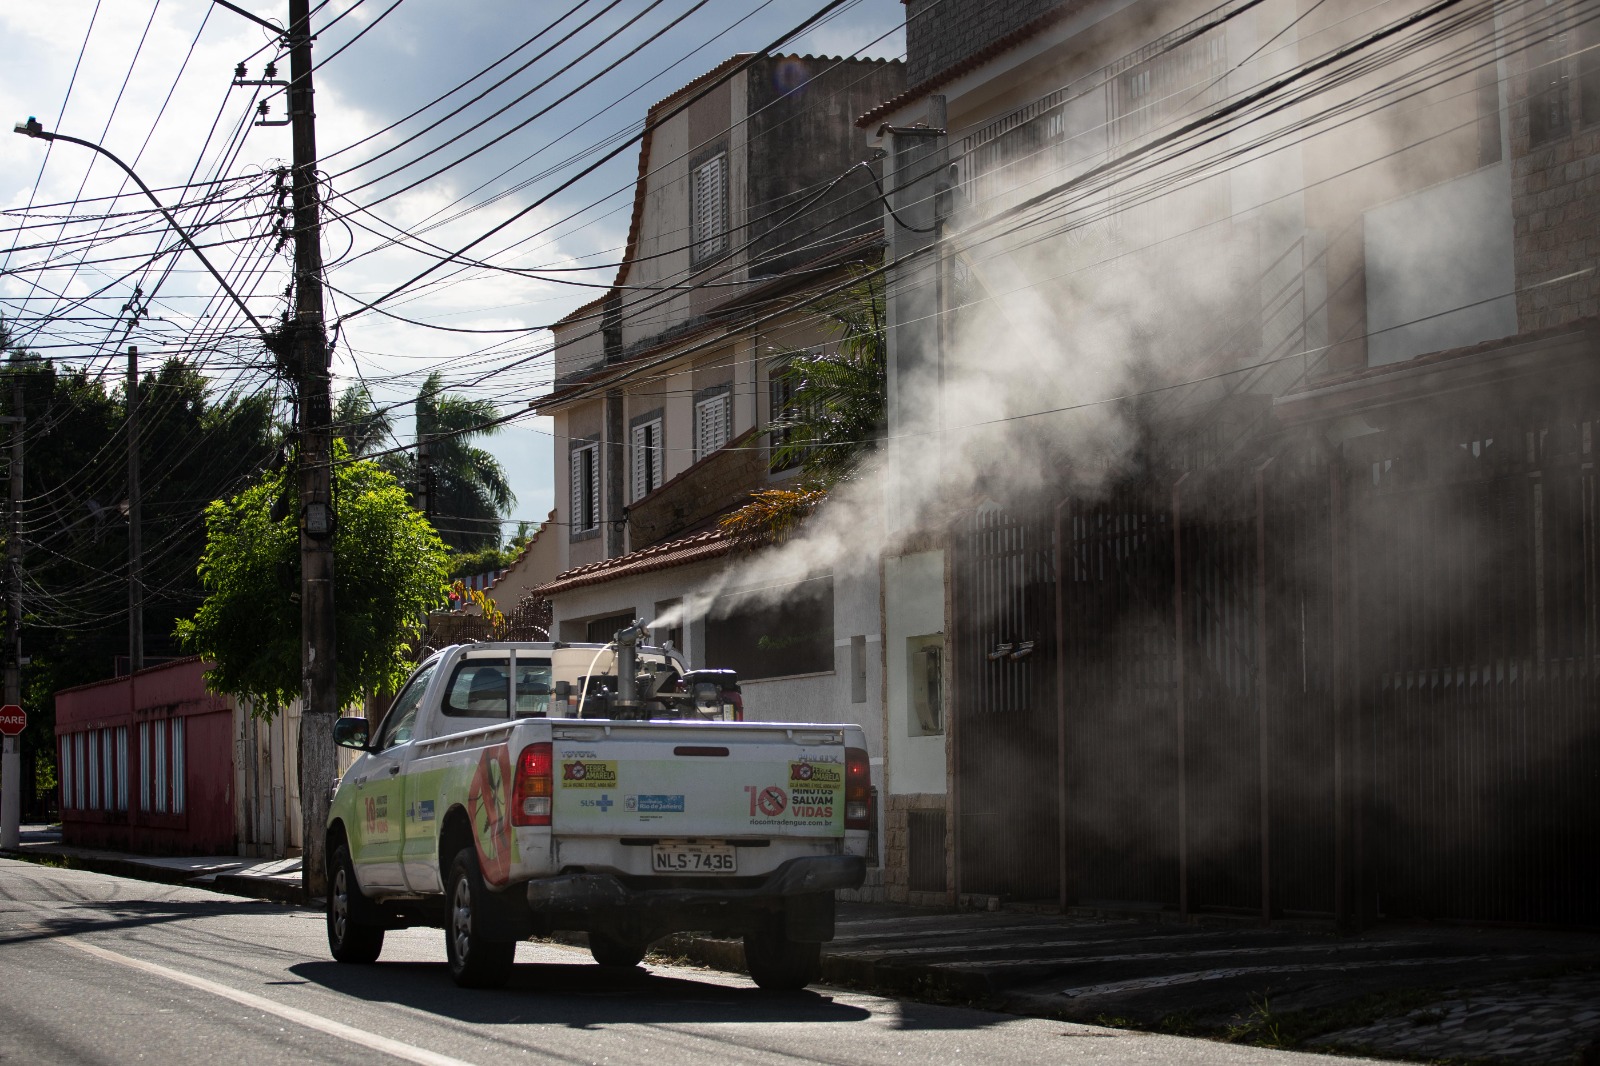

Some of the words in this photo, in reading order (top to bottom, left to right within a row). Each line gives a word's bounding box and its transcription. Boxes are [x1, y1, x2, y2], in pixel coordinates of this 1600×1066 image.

[0, 715, 24, 724] PARE
[586, 771, 615, 780] AMARELA
[813, 773, 840, 781] AMARELA
[744, 786, 788, 816] 10
[792, 796, 833, 805] SALVAM
[792, 806, 833, 817] VIDAS
